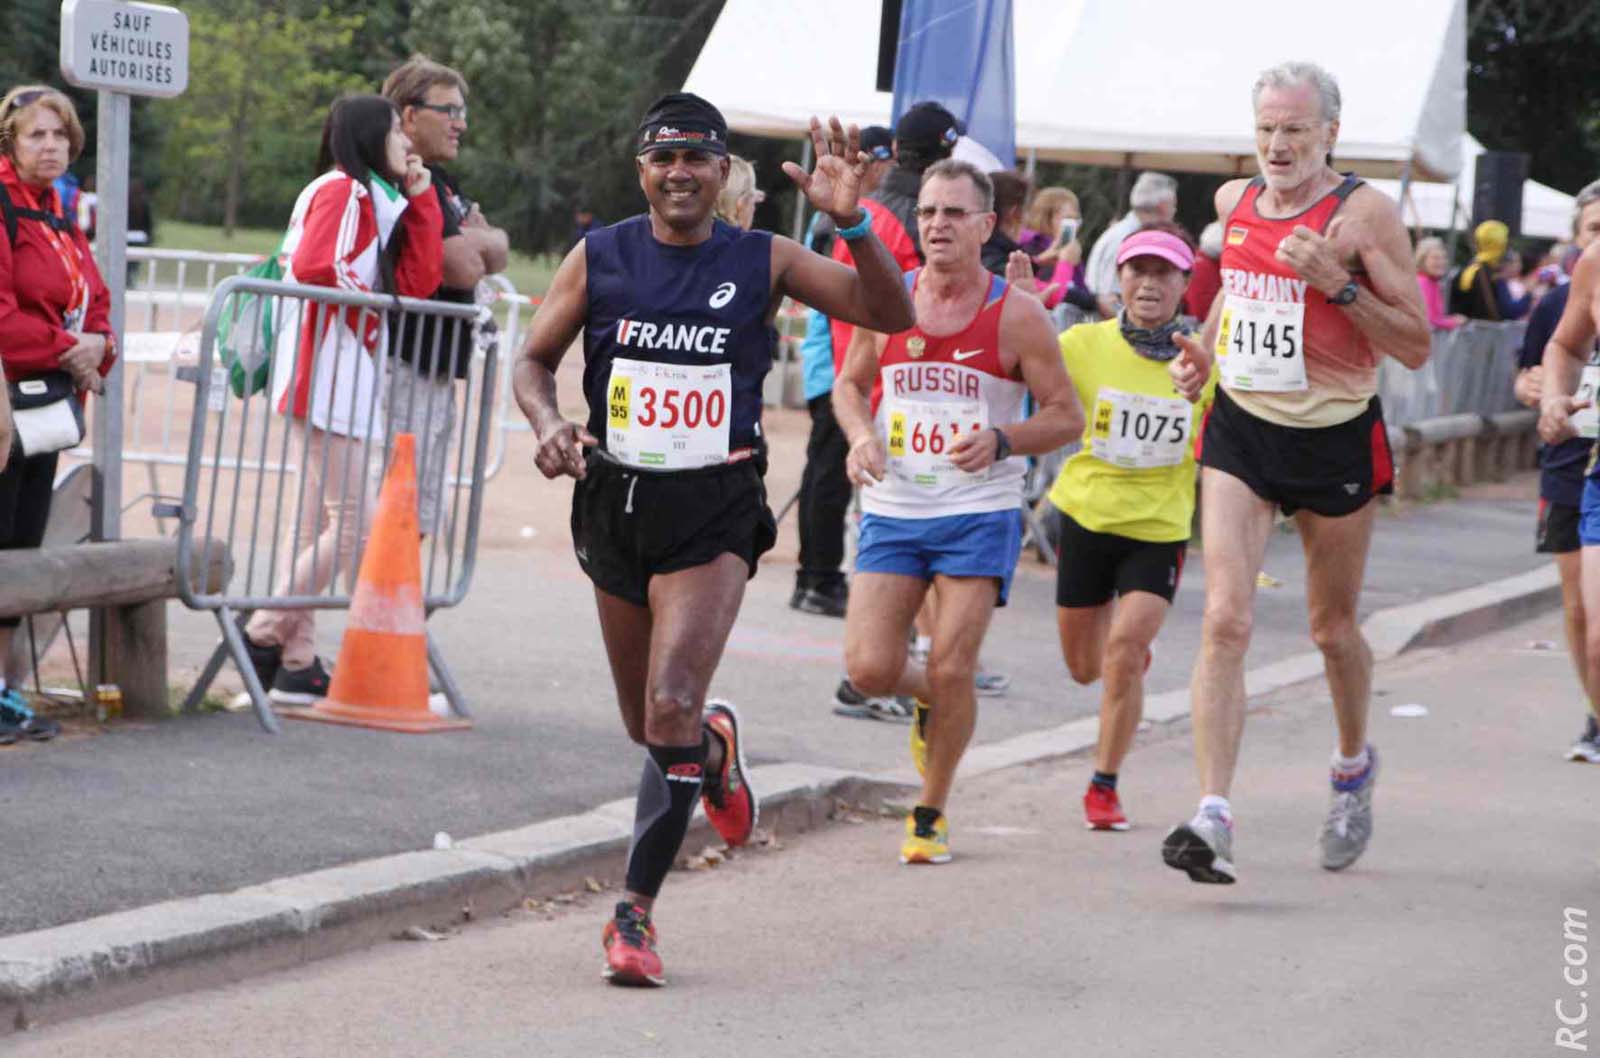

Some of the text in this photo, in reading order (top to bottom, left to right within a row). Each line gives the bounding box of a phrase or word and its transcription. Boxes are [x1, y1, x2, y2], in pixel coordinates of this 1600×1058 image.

[113, 11, 152, 32] SAUF
[90, 30, 173, 60] VÉHICULES
[89, 57, 173, 84] AUTORISÉS
[1219, 267, 1308, 304] ERMANY
[622, 319, 731, 354] FRANCE
[1232, 319, 1297, 359] 4145
[613, 385, 626, 401] M
[893, 366, 980, 399] RUSSIA
[610, 404, 628, 419] 55
[637, 386, 725, 429] 3500
[1120, 409, 1186, 443] 1075
